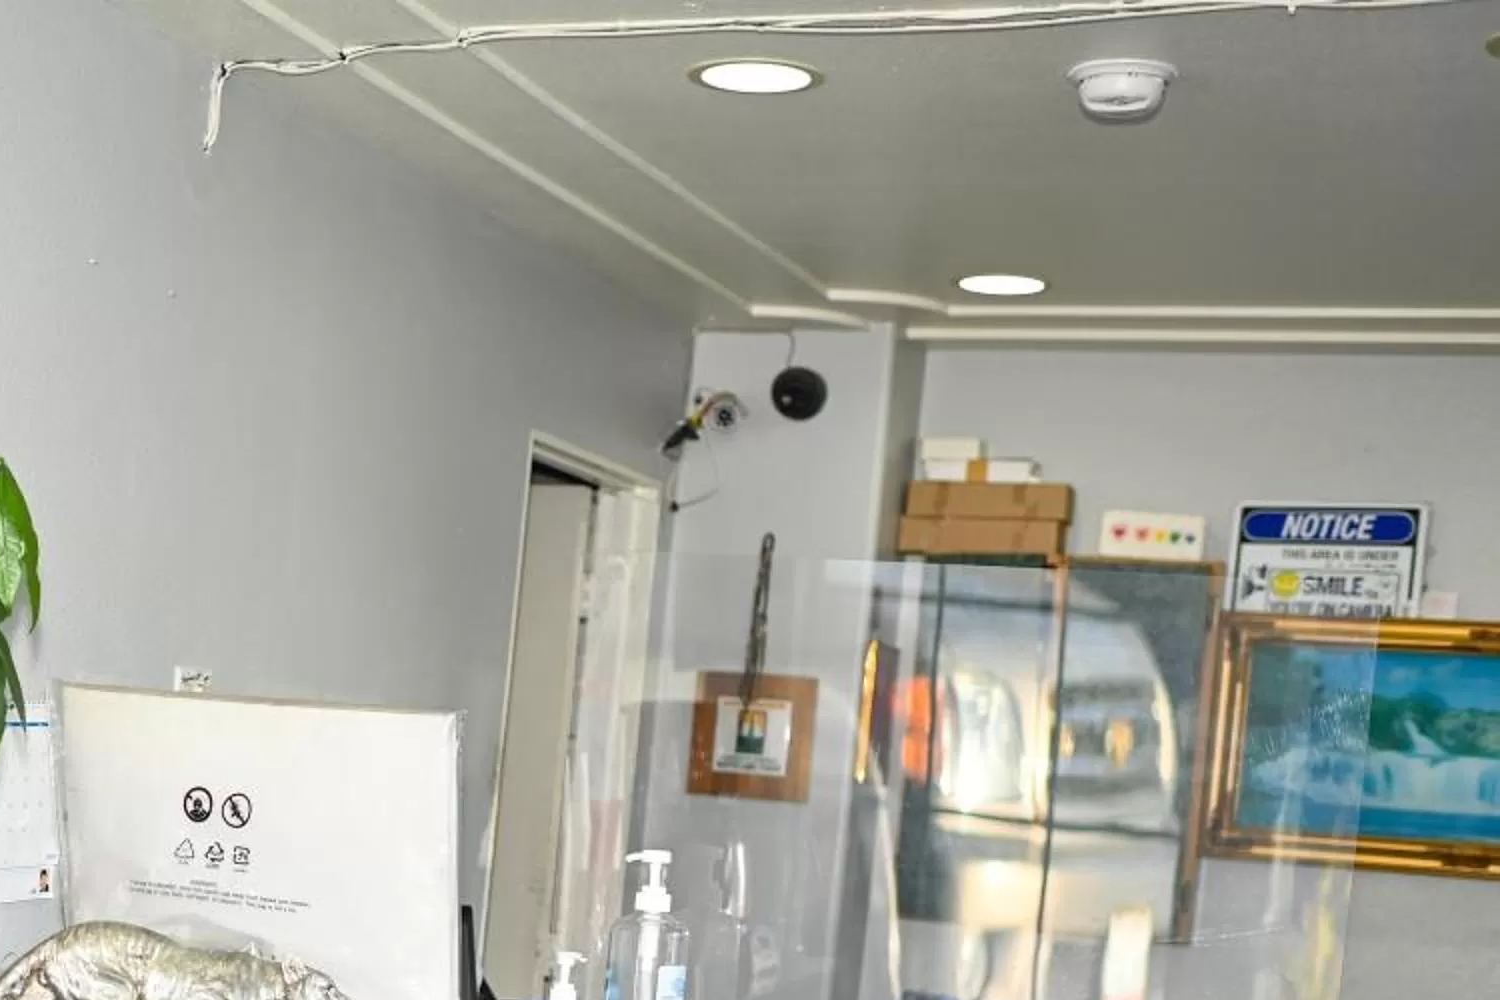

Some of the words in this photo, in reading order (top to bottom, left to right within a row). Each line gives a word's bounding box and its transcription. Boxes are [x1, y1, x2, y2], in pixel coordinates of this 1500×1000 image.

[1280, 512, 1377, 540] NOTICE
[1310, 550, 1340, 561] AREA
[1358, 551, 1399, 561] UNDER
[1303, 576, 1365, 597] SMILE
